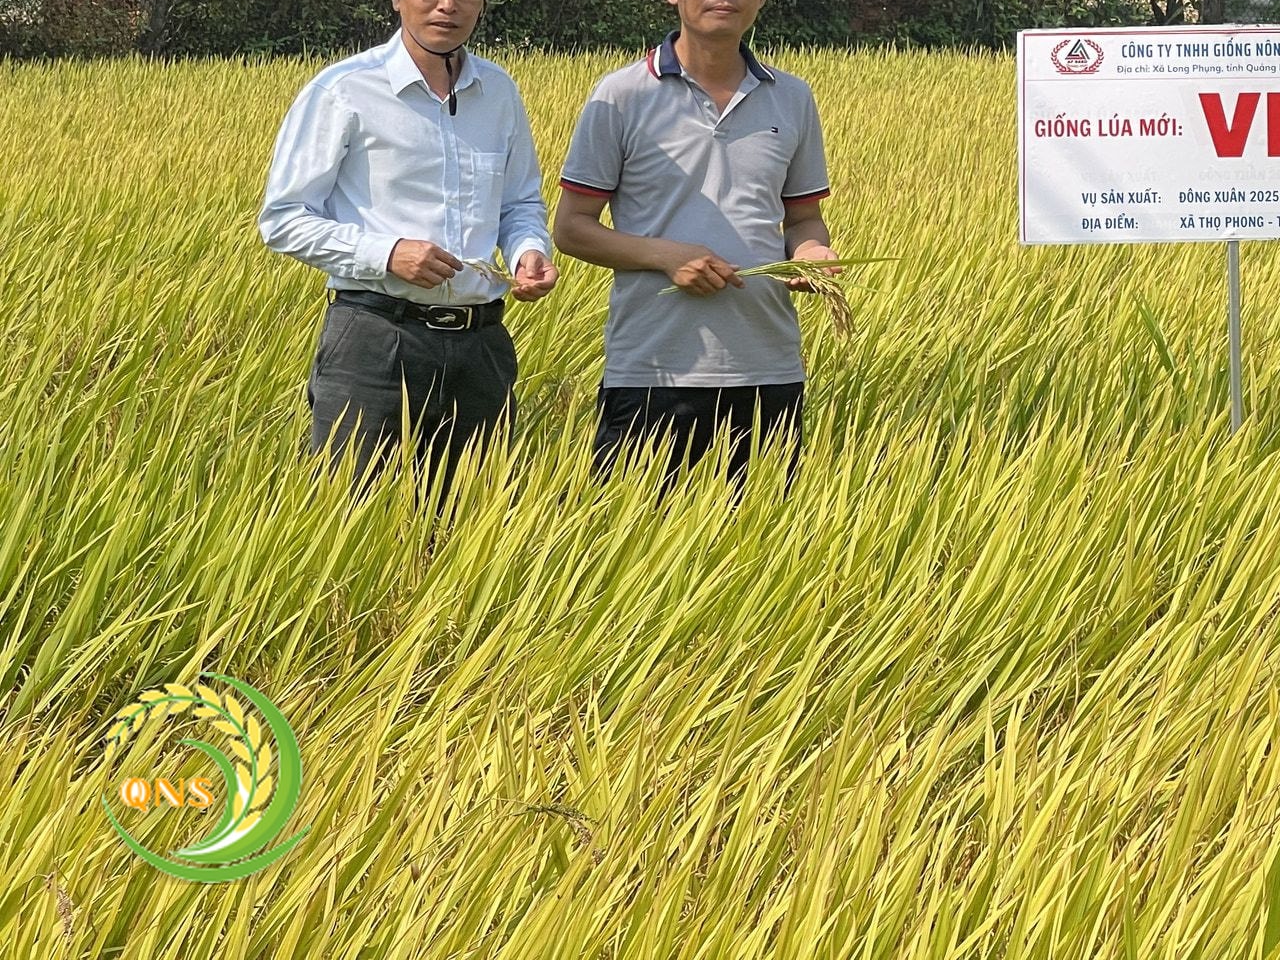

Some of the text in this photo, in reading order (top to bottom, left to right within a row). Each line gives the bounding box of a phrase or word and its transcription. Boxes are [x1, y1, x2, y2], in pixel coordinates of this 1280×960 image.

[1121, 41, 1153, 58] CÔNG
[1157, 43, 1172, 58] TY
[1176, 43, 1209, 58] TNHH
[1213, 37, 1251, 57] GIỐNG
[1116, 65, 1133, 75] Địa
[1152, 64, 1165, 73] Xã
[1167, 64, 1190, 74] Long
[1226, 63, 1244, 72] tỉnh
[1246, 63, 1277, 74] Quảng
[1034, 112, 1184, 138] GIỐNG LÚA MỚI:
[1081, 192, 1097, 207] VỤ
[1100, 188, 1124, 204] SẢN
[1128, 188, 1162, 204] XUẤT:
[1179, 187, 1211, 203] ĐÔNG
[1214, 187, 1246, 203] XUÂN
[1082, 217, 1102, 232] ĐỊA
[1105, 212, 1139, 230] ĐIỂM:
[1179, 214, 1195, 229] XÃ
[1199, 216, 1221, 231] THỌ
[1225, 215, 1264, 228] PHONG
